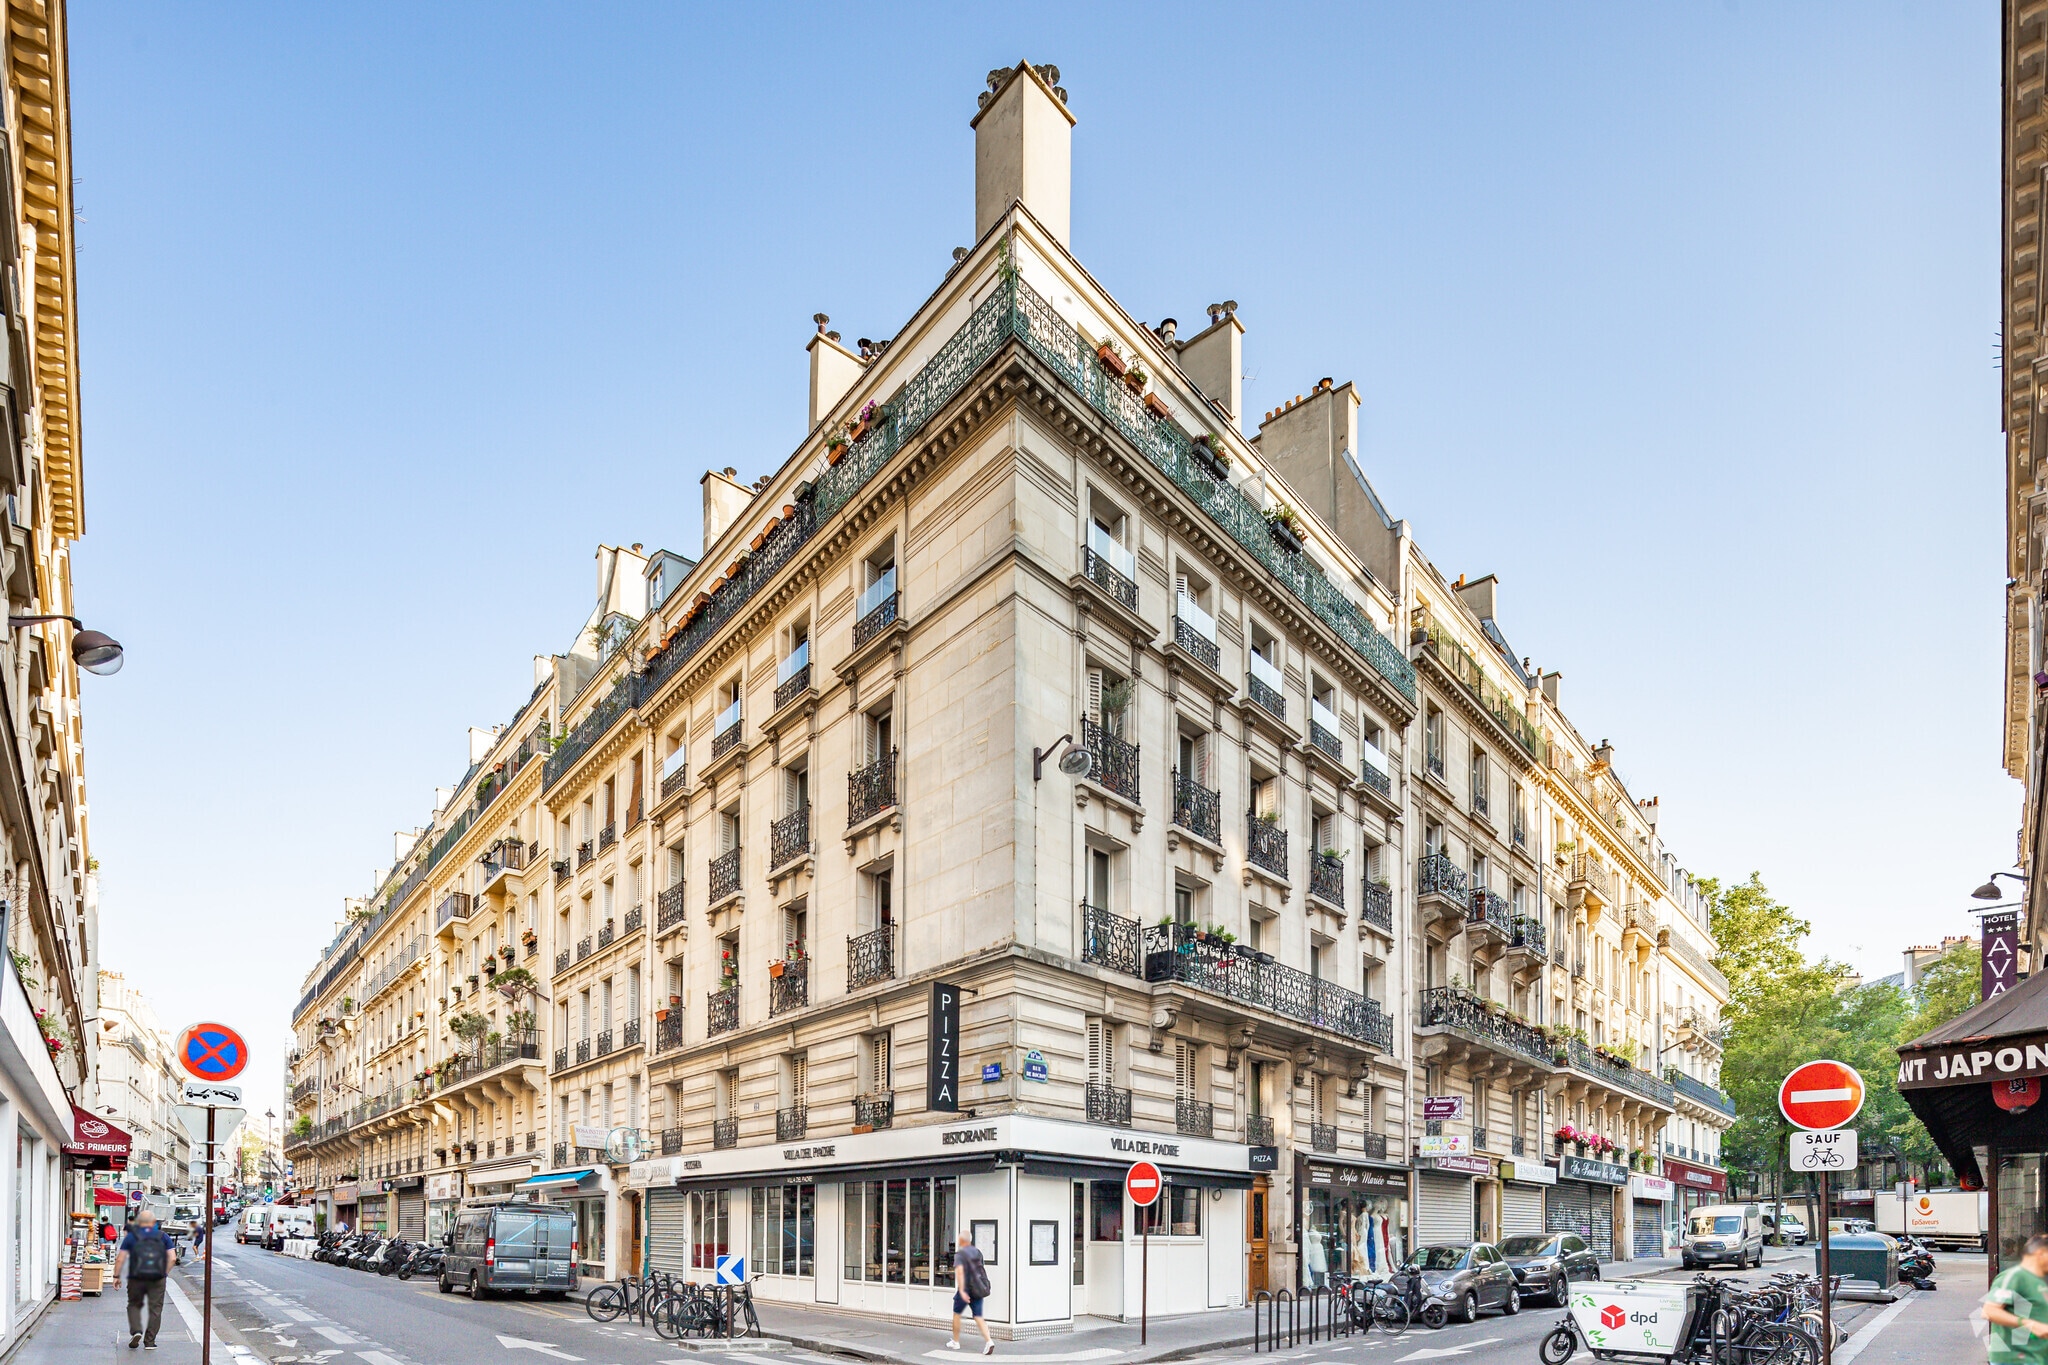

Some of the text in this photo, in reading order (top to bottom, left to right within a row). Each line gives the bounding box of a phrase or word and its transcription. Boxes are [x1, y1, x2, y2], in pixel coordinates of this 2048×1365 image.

[1984, 914, 2016, 924] HÔTEL
[938, 993, 952, 1103] PIZZA
[942, 1127, 998, 1145] RISTORANTE
[1806, 1133, 1841, 1144] SAUF
[62, 1141, 127, 1152] PARIS PRIMEURS
[783, 1145, 836, 1160] VILLA DEL PADRE
[1110, 1137, 1180, 1157] VILLA DEL PADRE
[1340, 1167, 1358, 1186] Sofia
[1630, 1311, 1658, 1326] dpd
